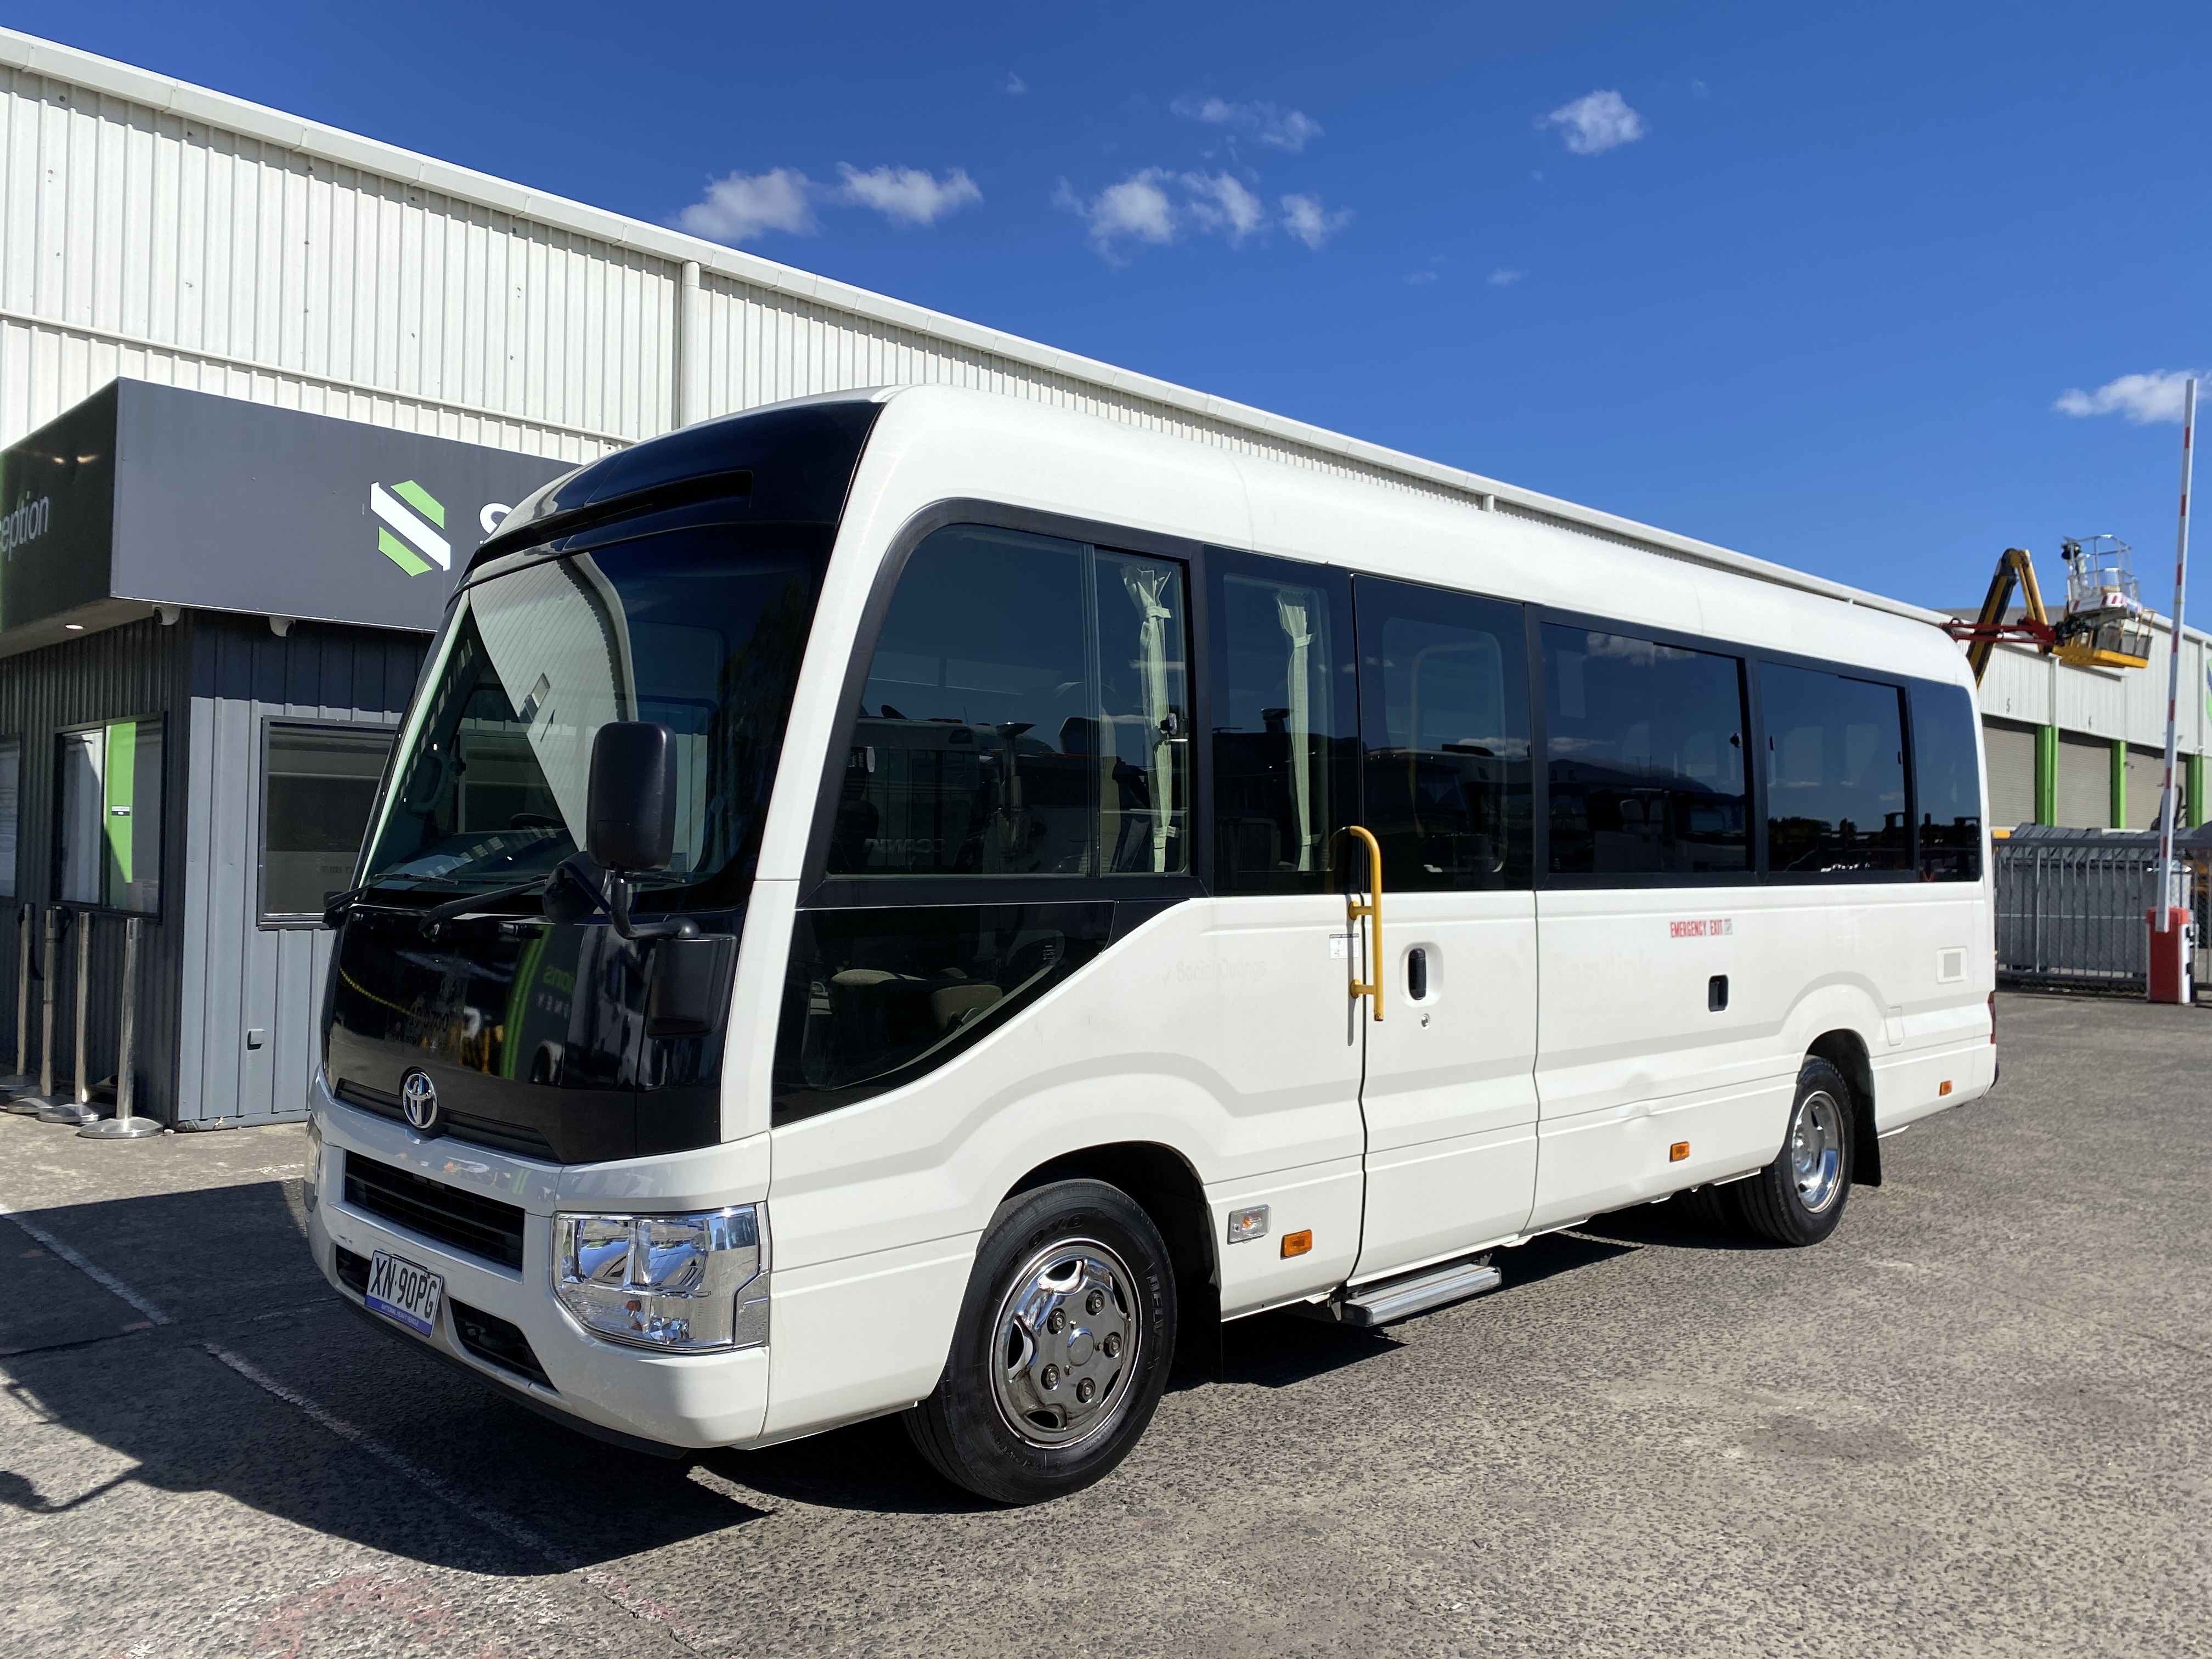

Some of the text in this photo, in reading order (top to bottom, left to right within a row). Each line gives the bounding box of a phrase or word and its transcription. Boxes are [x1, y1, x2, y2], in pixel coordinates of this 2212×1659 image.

[0, 490, 49, 562] eption
[1671, 921, 1707, 938] EMERGENCY
[1710, 919, 1723, 935] EXIT
